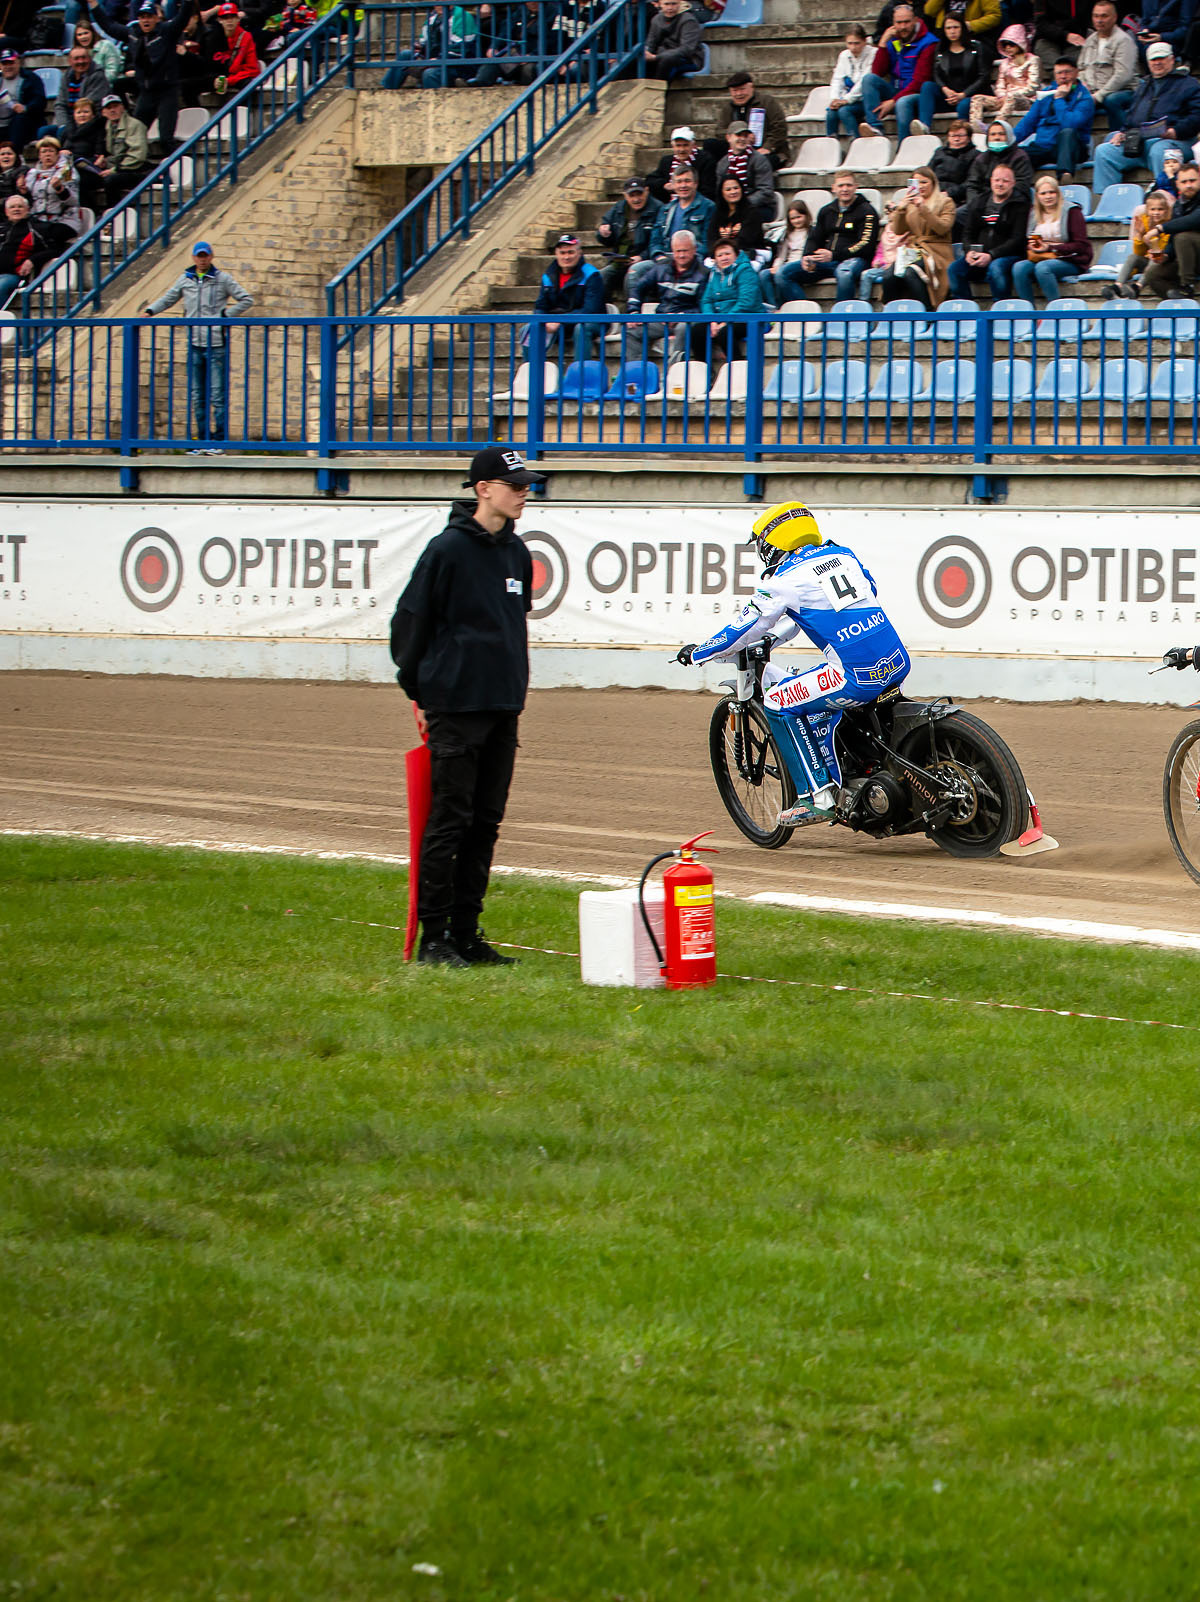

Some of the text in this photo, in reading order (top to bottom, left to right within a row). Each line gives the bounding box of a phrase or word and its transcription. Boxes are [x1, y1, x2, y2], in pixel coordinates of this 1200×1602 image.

[199, 536, 379, 590] OPTIBET
[586, 541, 756, 595] OPTIBE
[812, 557, 843, 577] LAMPART
[829, 574, 858, 600] 4
[198, 592, 378, 609] SPORTA BĀRS
[584, 600, 743, 614] SPORTA BĀ
[1010, 608, 1128, 623] SPORTA
[836, 611, 886, 642] STOLARO
[869, 661, 898, 680] REALL
[796, 717, 807, 735] Club
[802, 734, 820, 770] Diamond
